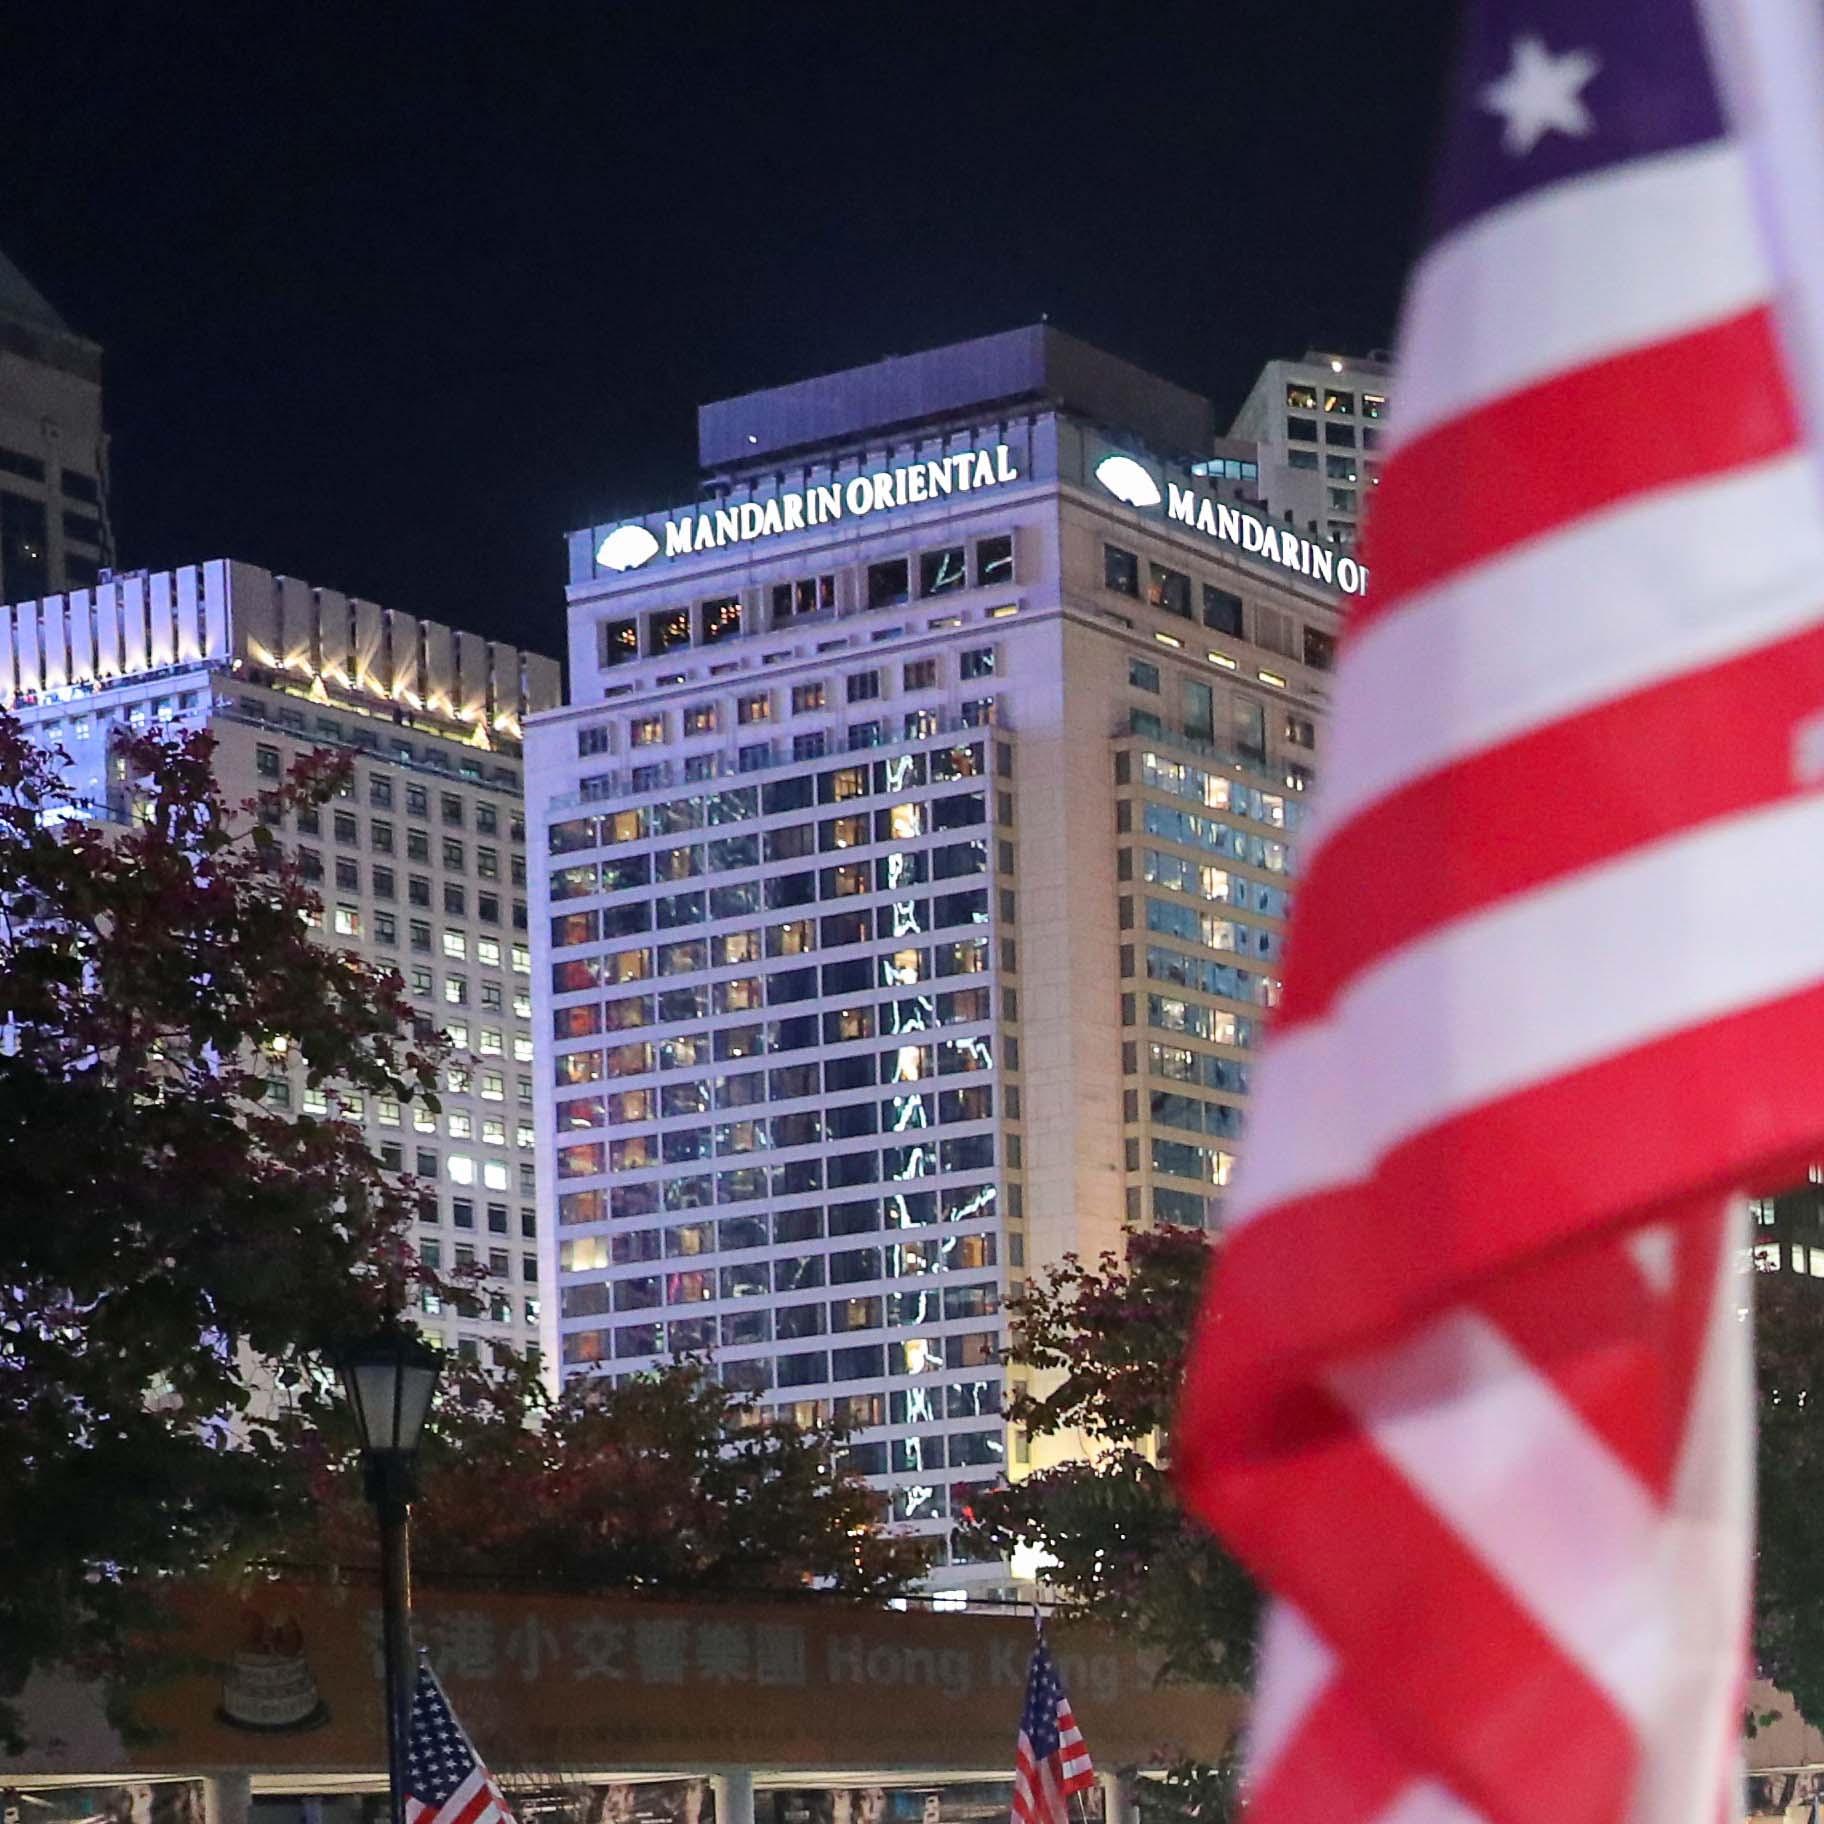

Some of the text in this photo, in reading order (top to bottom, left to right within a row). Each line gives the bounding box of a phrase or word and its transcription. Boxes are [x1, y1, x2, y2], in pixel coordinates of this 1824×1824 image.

[665, 446, 1017, 557] MANDARIN ORIENTAL
[1167, 482, 1333, 584] MANDARIN
[825, 1635, 970, 1700] Hong
[990, 1638, 1119, 1703] Kng
